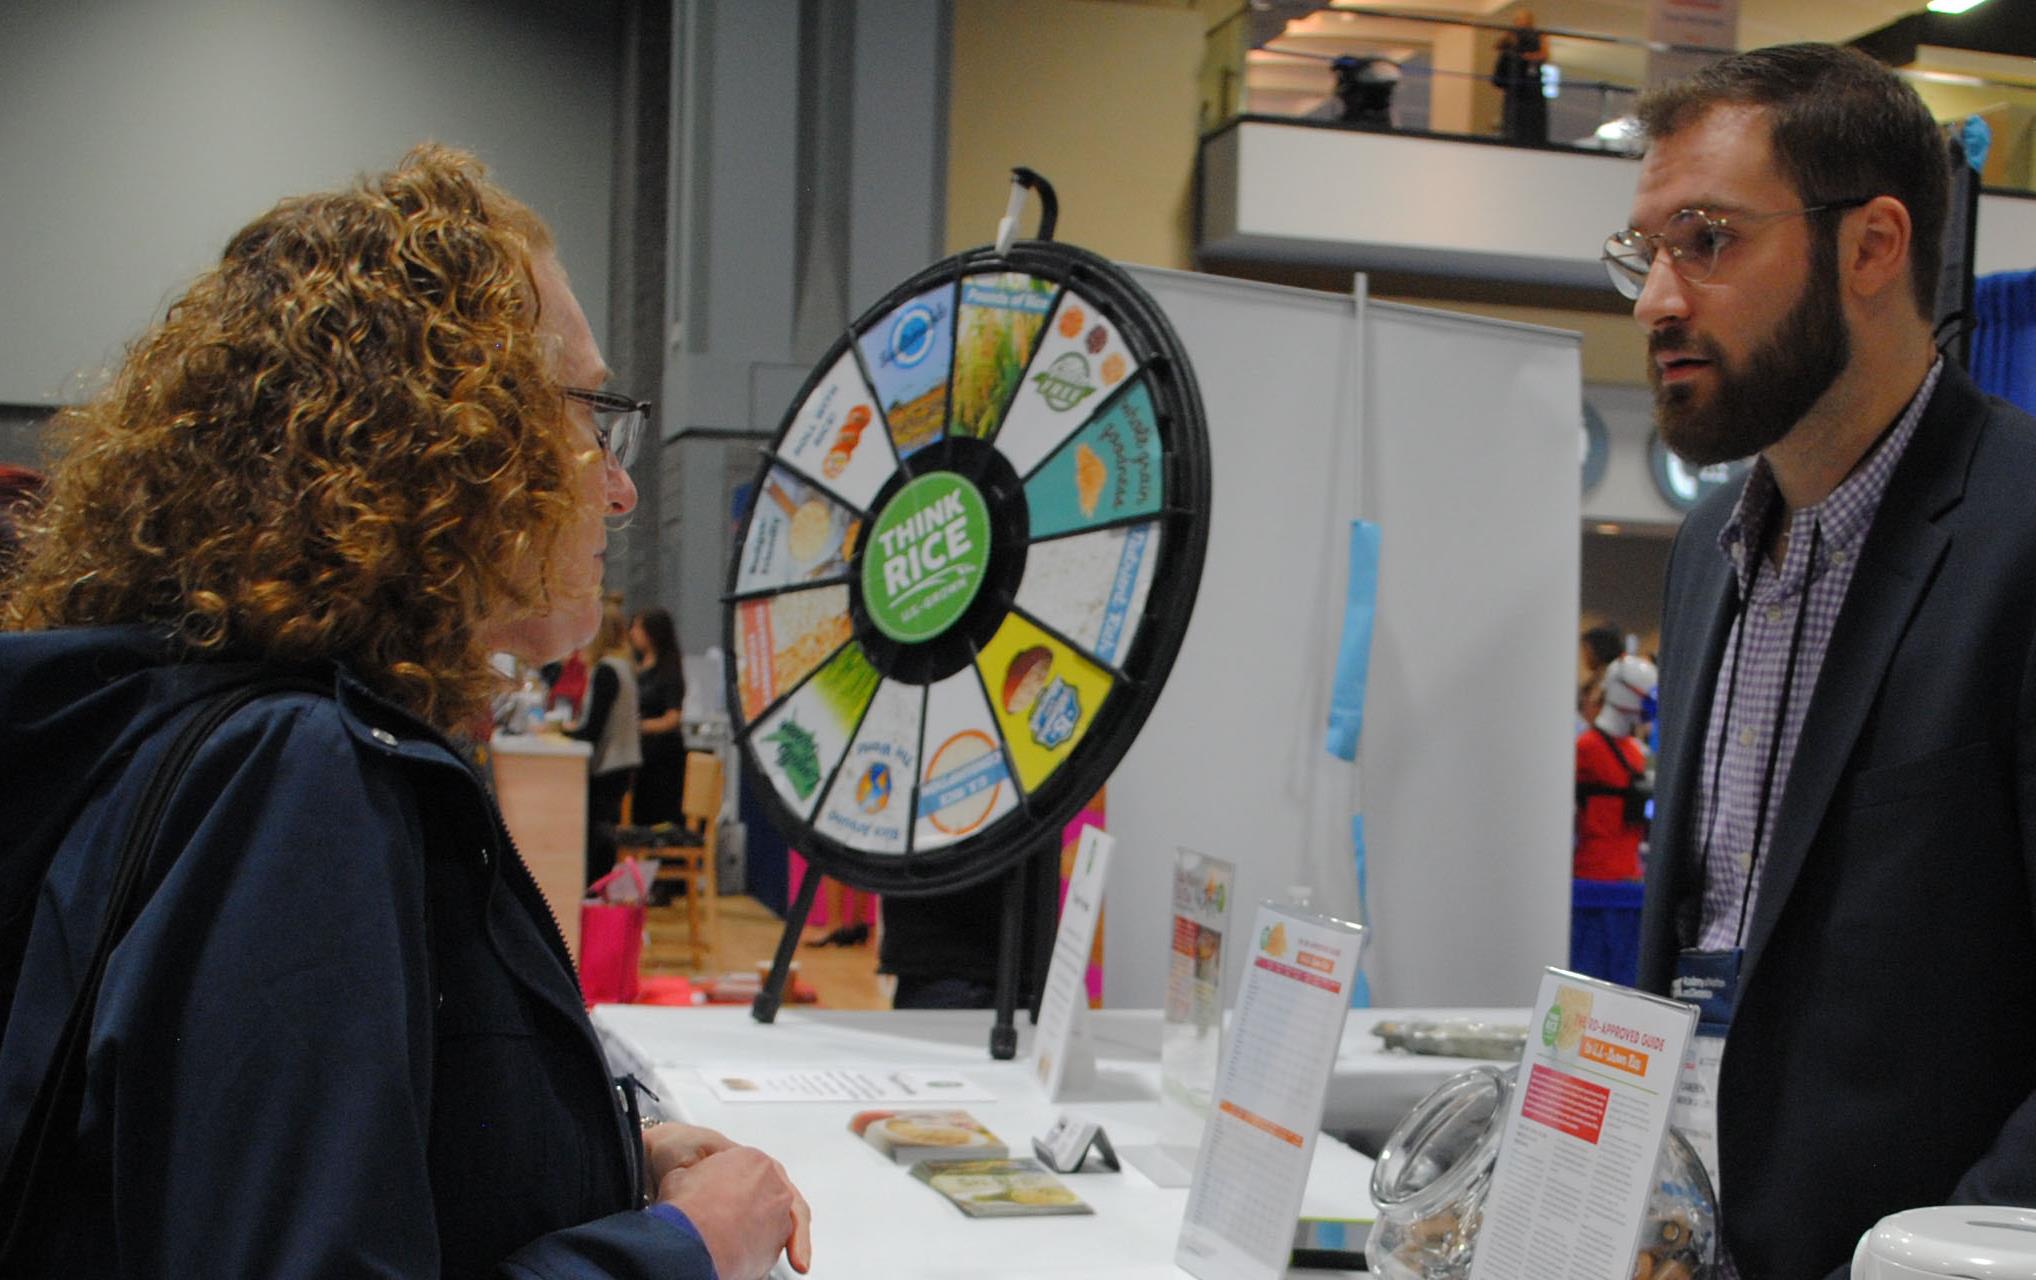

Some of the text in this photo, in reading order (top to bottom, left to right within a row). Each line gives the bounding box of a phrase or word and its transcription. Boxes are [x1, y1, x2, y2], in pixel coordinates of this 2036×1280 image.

[878, 488, 966, 557] THINK
[883, 516, 973, 596] RICE
[1641, 1032, 1666, 1053] GUIDE
